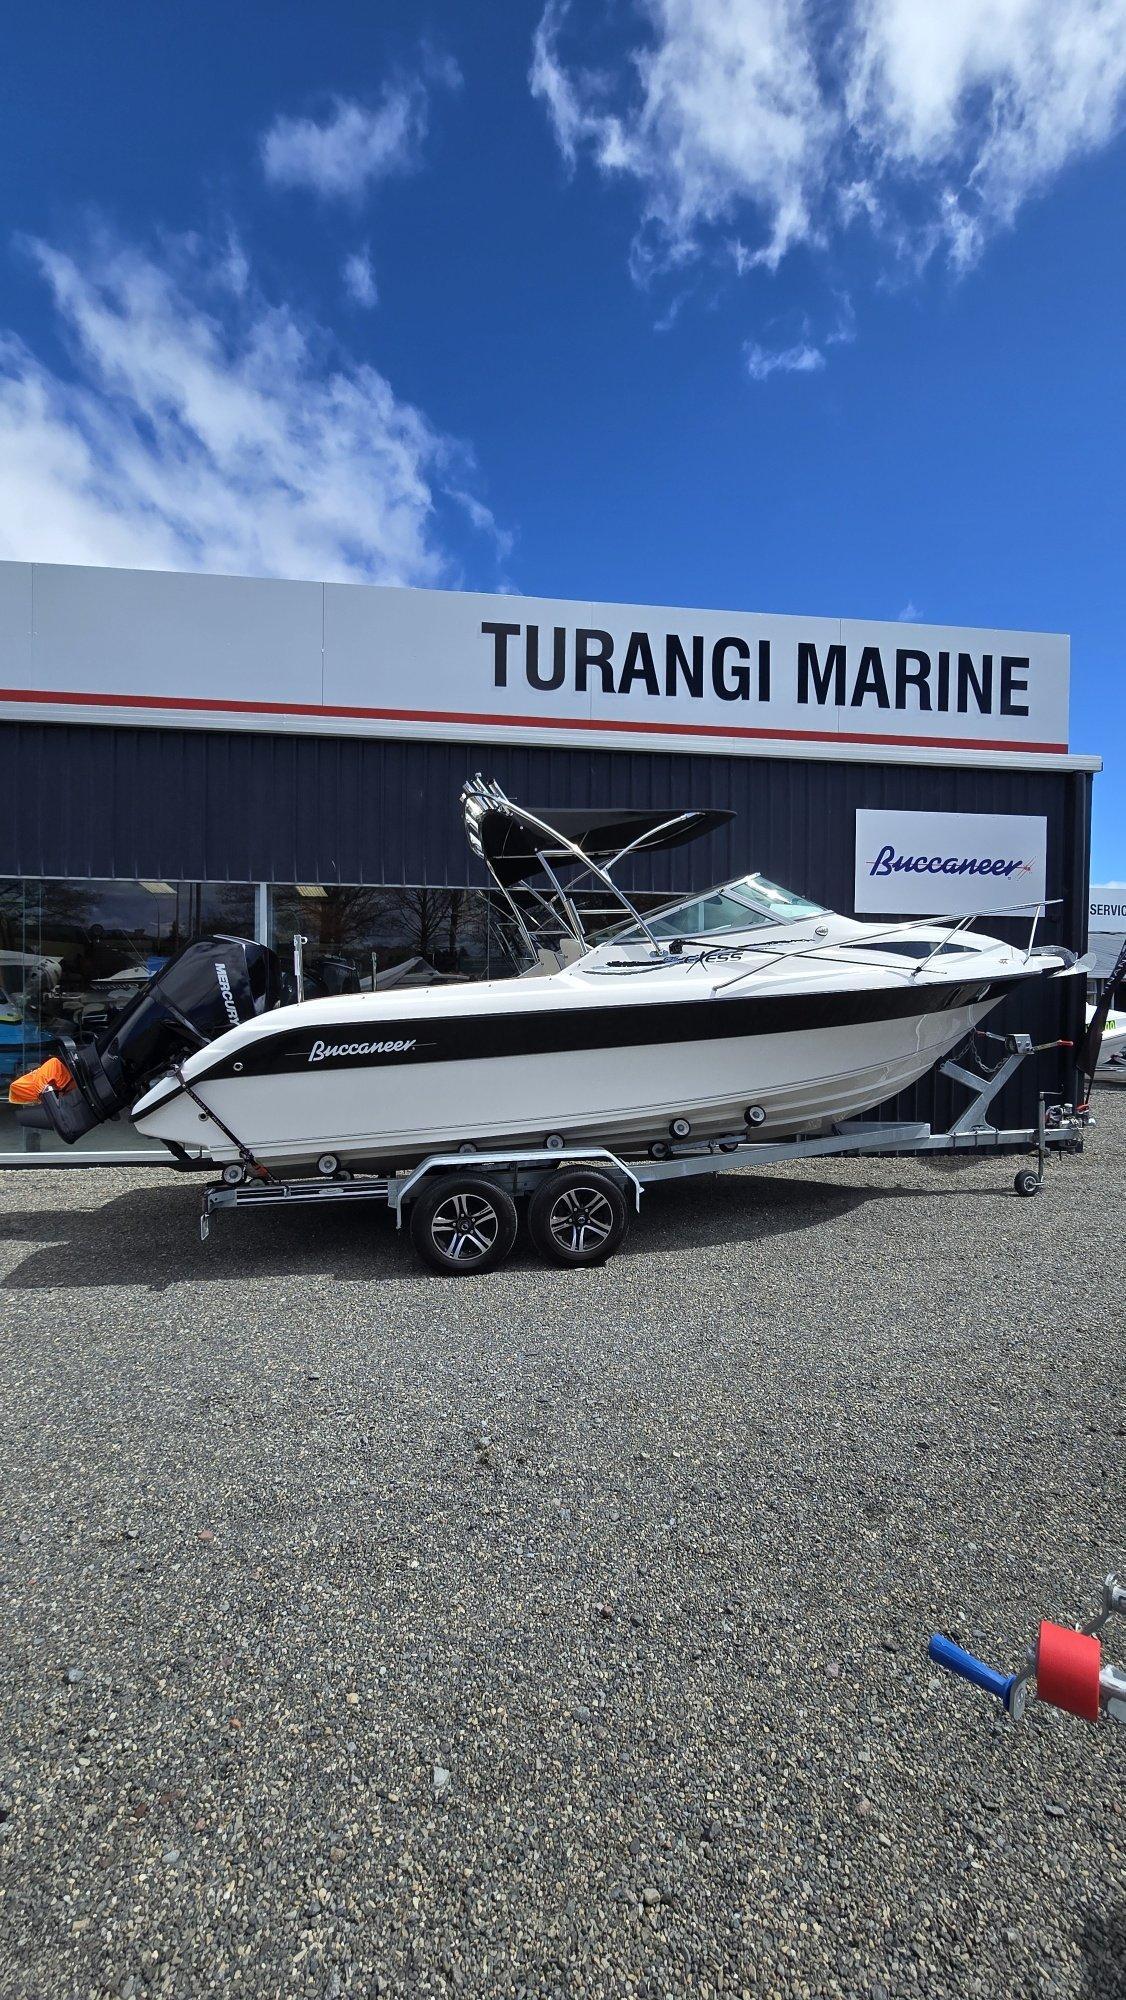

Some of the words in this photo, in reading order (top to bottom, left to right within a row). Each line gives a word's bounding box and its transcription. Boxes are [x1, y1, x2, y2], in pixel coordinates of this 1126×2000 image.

[481, 621, 771, 702] TURANGI
[796, 642, 1031, 717] MARINE
[869, 845, 1023, 877] Buccaneer
[214, 962, 240, 1027] MERCURY
[308, 1039, 417, 1062] Buccaneer
